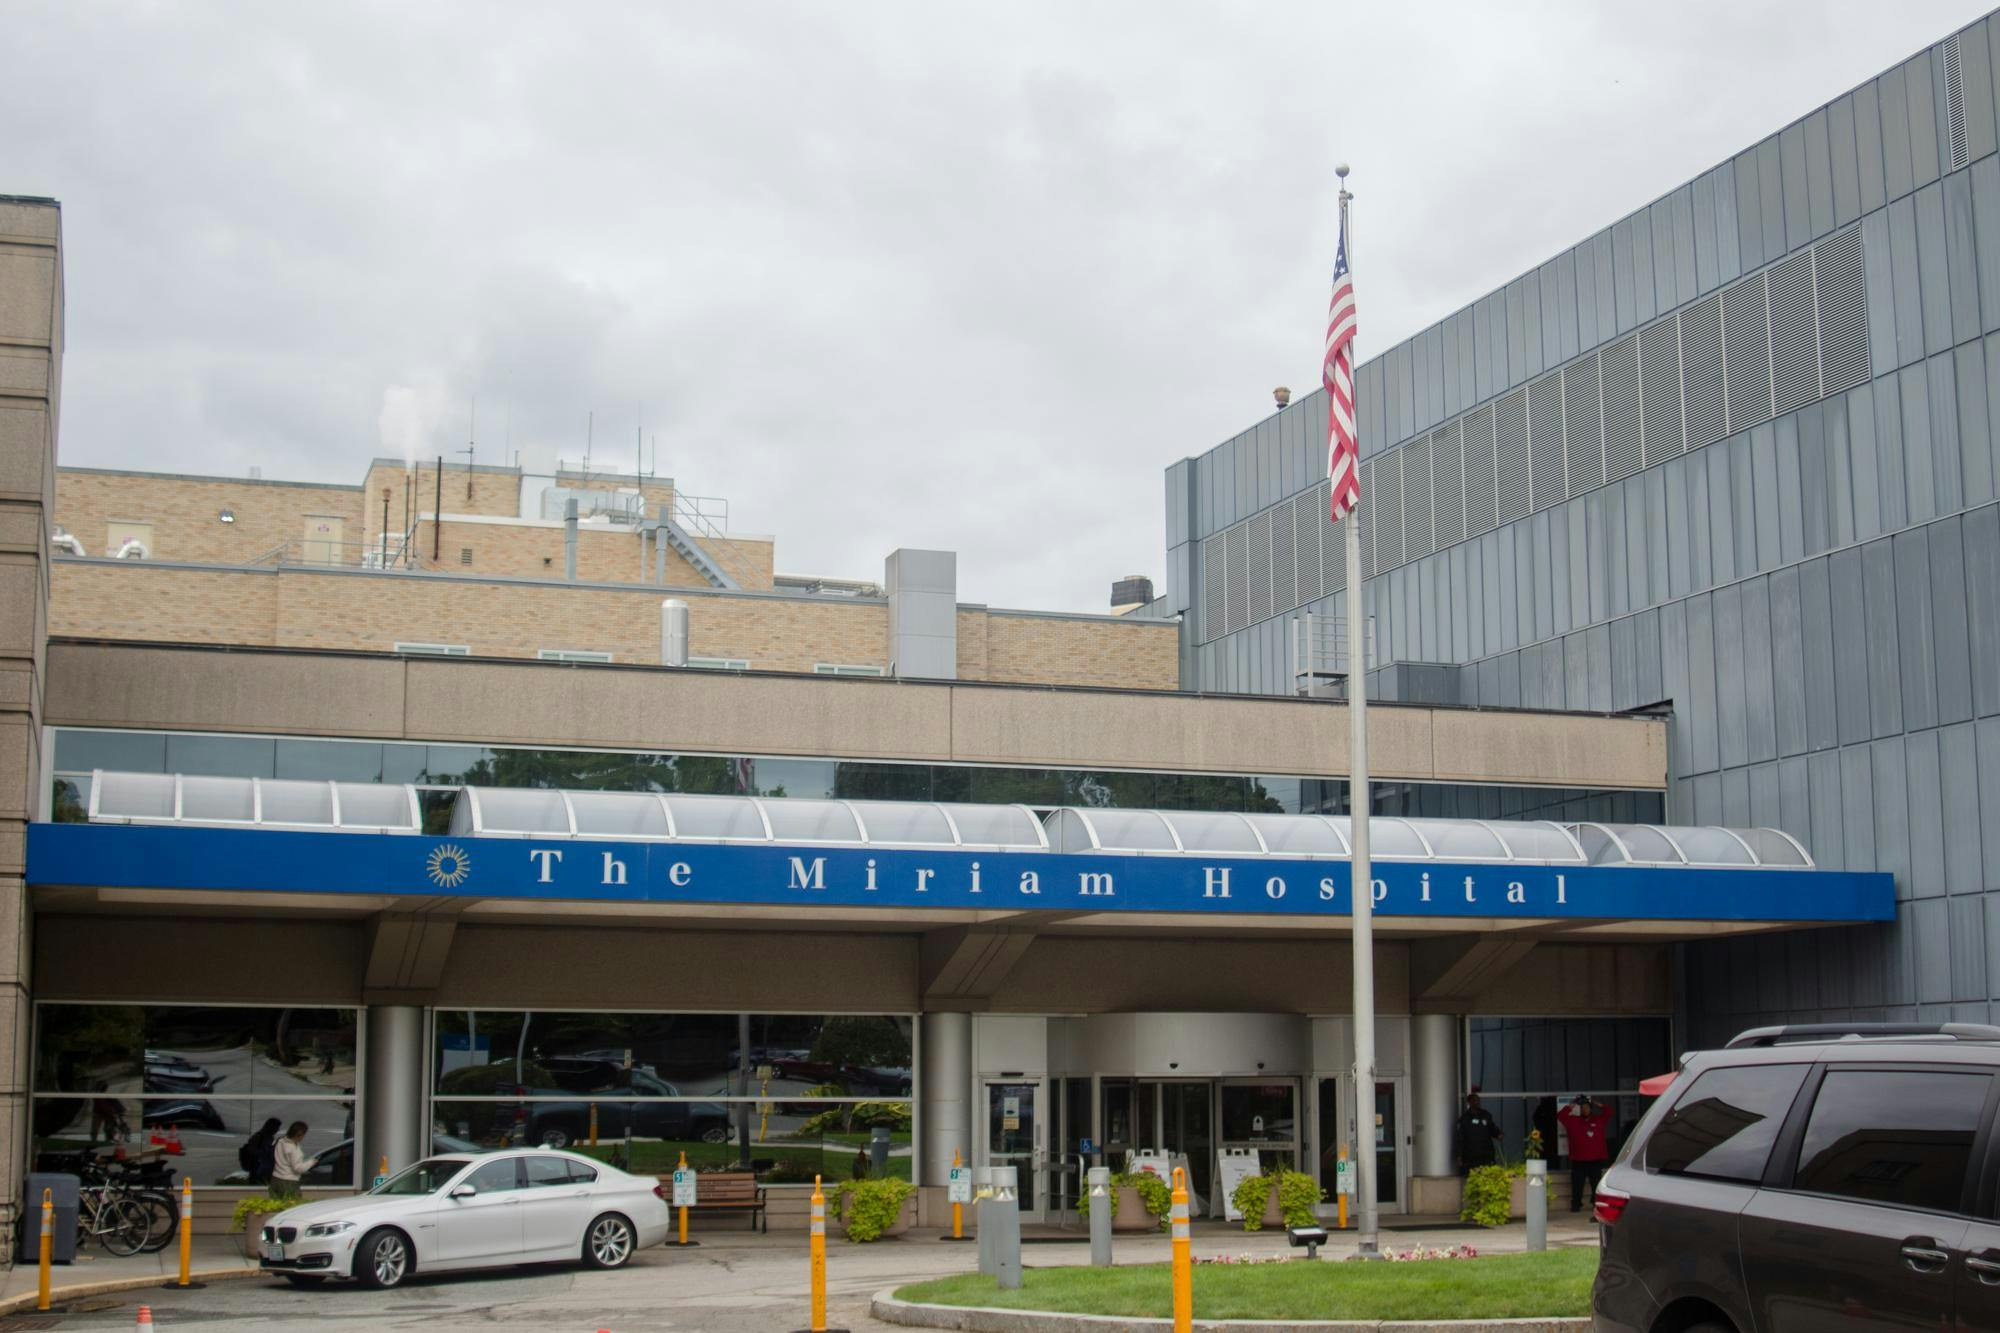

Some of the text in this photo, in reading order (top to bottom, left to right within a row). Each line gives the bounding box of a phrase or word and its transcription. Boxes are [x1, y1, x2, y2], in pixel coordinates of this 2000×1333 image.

[530, 849, 1566, 909] The Miriam Hospital
